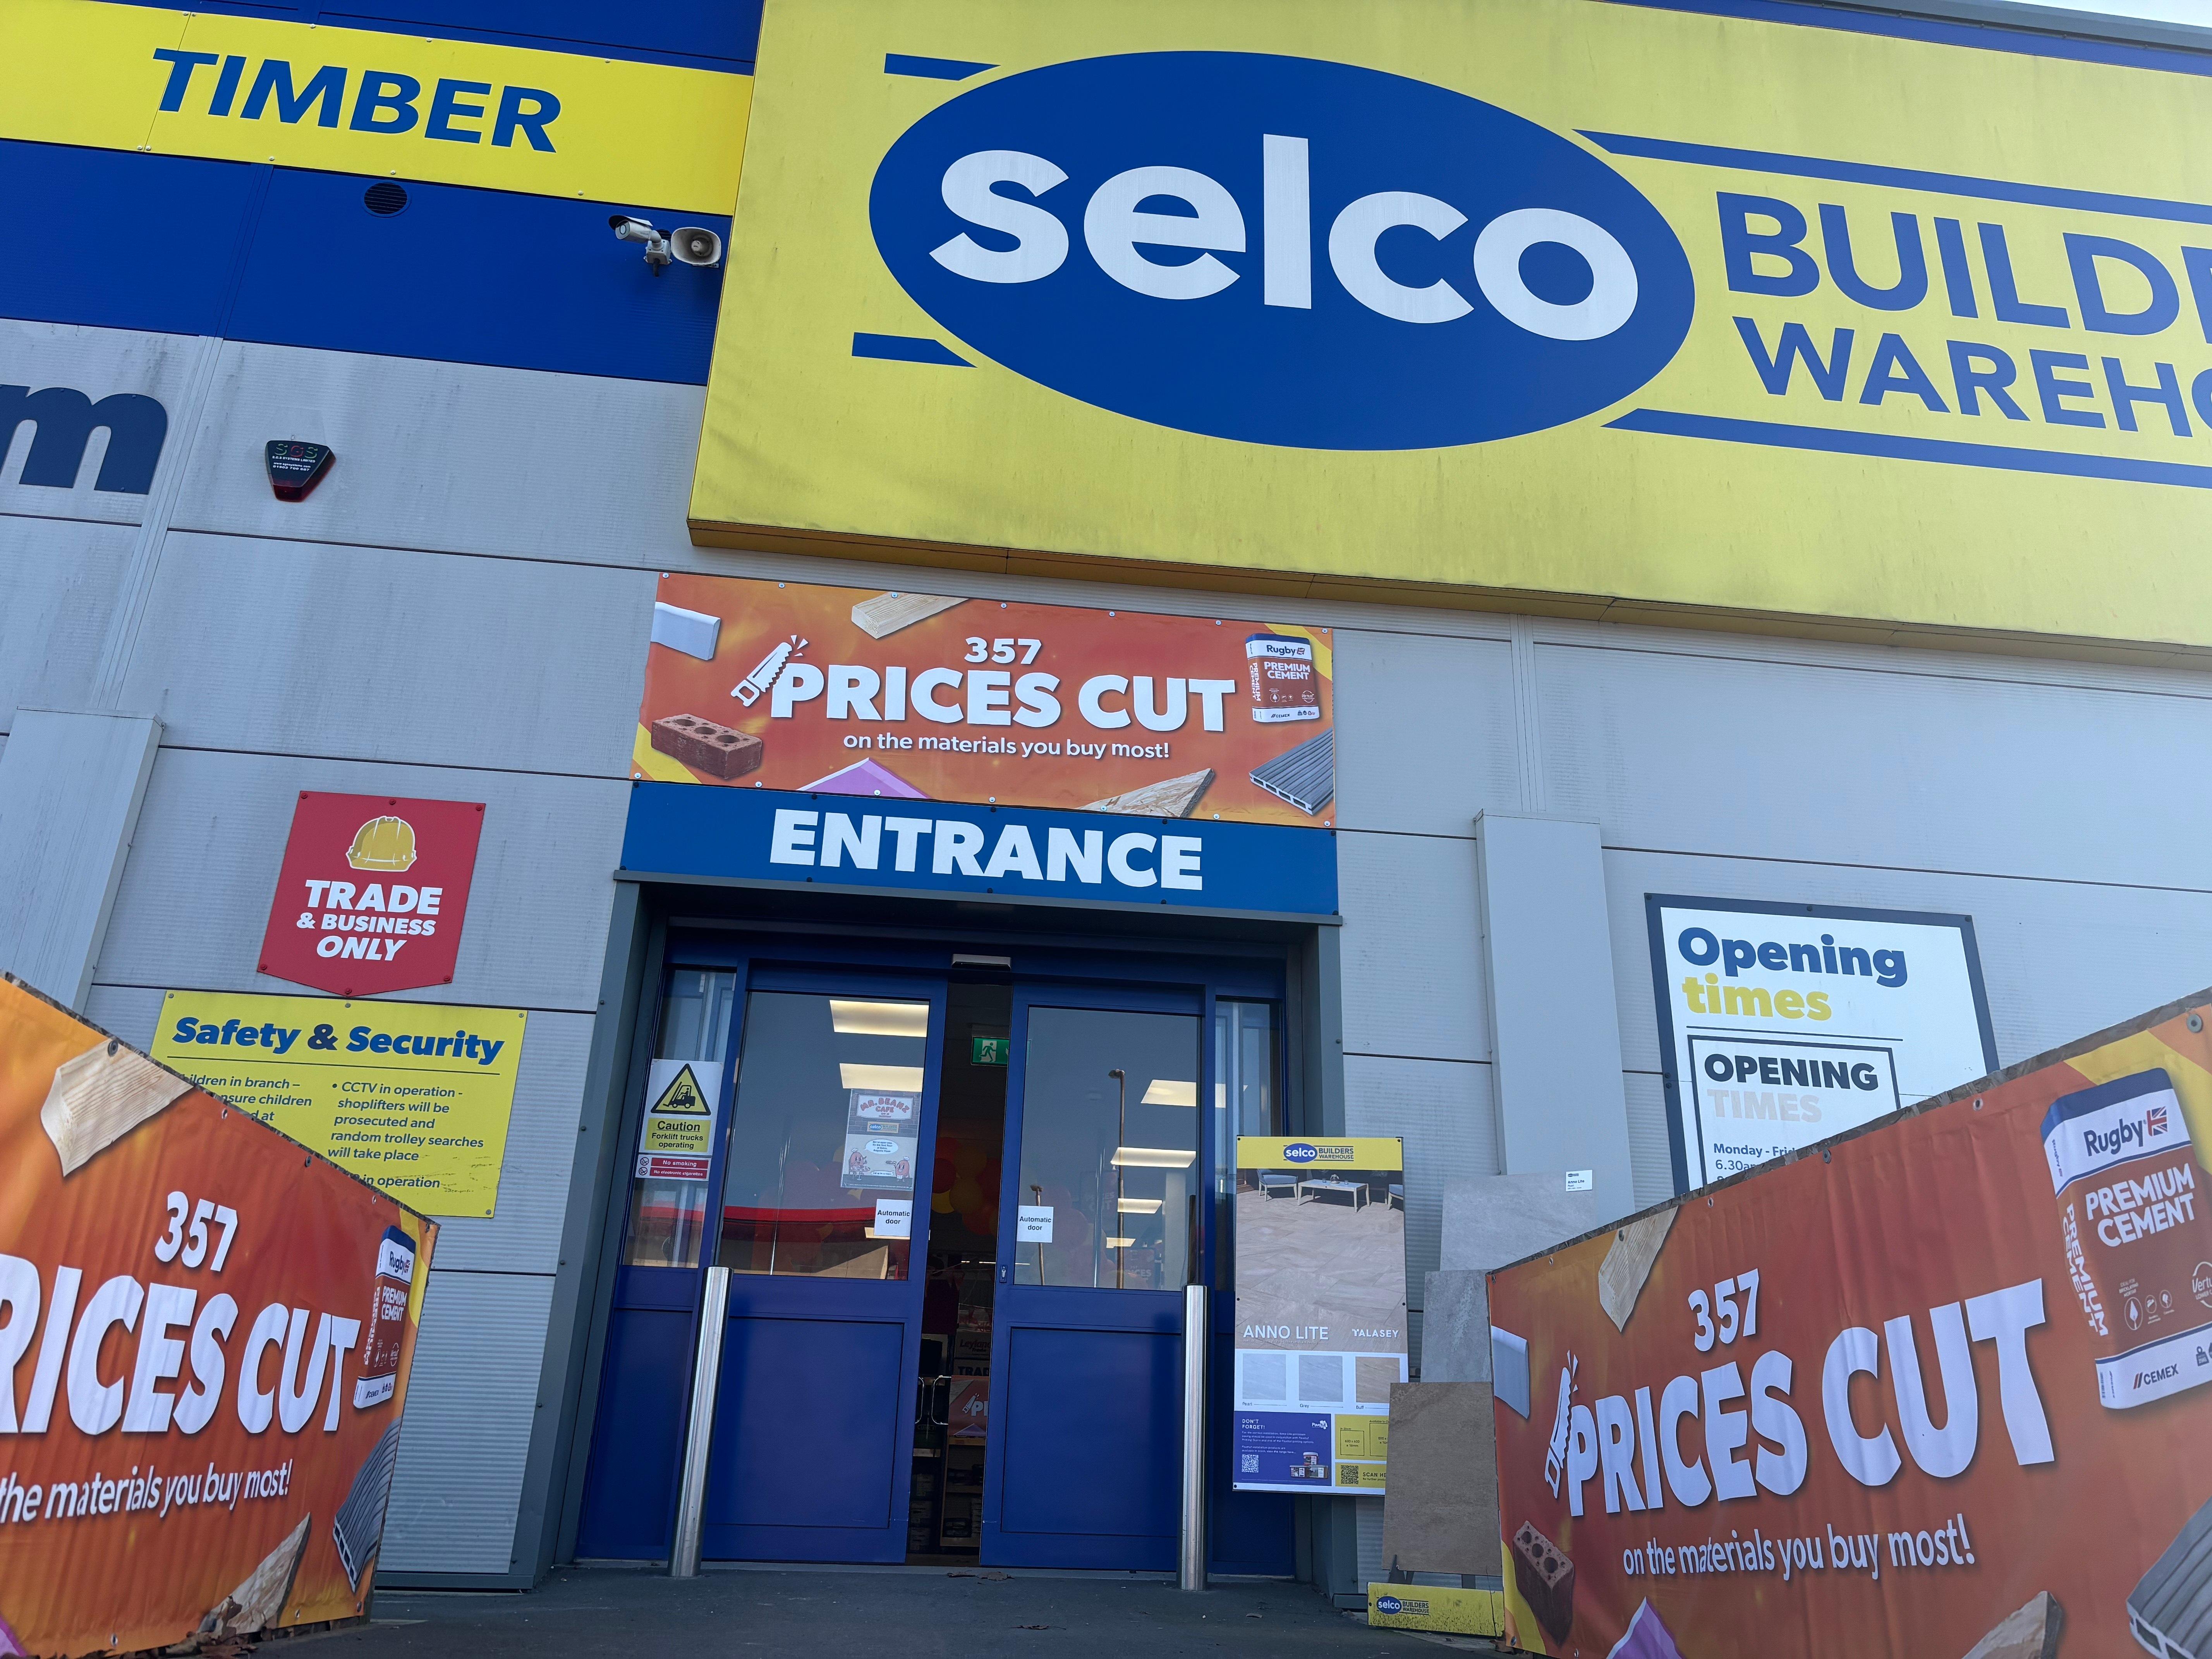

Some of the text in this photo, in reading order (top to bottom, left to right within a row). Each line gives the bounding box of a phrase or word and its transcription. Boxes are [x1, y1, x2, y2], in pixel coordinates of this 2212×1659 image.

[153, 48, 562, 153] TIMBER
[929, 134, 1638, 340] selco
[1732, 316, 2212, 437] WAREH
[965, 637, 1042, 665] 357
[1266, 645, 1295, 656] Rugby
[1264, 661, 1310, 673] PREMIUM
[1267, 671, 1309, 680] CEMENT
[1253, 663, 1261, 701] PREMIUM
[770, 664, 1235, 732] PRICES CUT
[843, 732, 1170, 761] on the materials you buy most!
[769, 809, 1203, 891] ENTRANCE
[306, 880, 443, 915] TRADE
[297, 912, 436, 936] & BUSINESS
[316, 936, 407, 961] ONLY
[1678, 927, 1908, 988] Opening
[1681, 972, 1832, 1021] times
[172, 1017, 504, 1065] Safety & Security
[230, 1076, 241, 1086] in
[245, 1077, 290, 1089] branch
[1704, 1053, 1879, 1091] OPENING
[259, 1094, 312, 1106] children
[342, 1082, 378, 1092] CCTV
[380, 1084, 390, 1094] in
[394, 1086, 455, 1097] operation
[261, 1111, 275, 1121] at
[338, 1098, 450, 1113] shoplifters will be
[878, 1098, 910, 1113] BEANZ
[1707, 1089, 1822, 1123] TIMES
[334, 1116, 435, 1128] prosecuted and
[657, 1120, 700, 1131] Caution
[331, 1131, 484, 1147] random trolley searches
[2083, 1118, 2144, 1156] Rugby
[328, 1147, 419, 1161] will take place
[1286, 1147, 1316, 1157] selco
[1714, 1144, 1762, 1158] Monday
[377, 1176, 440, 1188] operation
[2085, 1163, 2195, 1221] PREMIUM
[155, 1191, 237, 1272] 357
[2097, 1192, 2195, 1247] CEMENT
[390, 1250, 405, 1274] Rugby
[2062, 1216, 2099, 1334] CEMENT
[2066, 1203, 2108, 1336] PREMIUM
[382, 1286, 407, 1307] PREMIUM
[381, 1304, 404, 1322] CEMENT
[1688, 1268, 1759, 1352] 357
[1243, 1325, 1329, 1340] ANNO LITE
[1352, 1329, 1398, 1338] TALASEY
[237, 1303, 361, 1434] CUT
[2143, 1364, 2179, 1385] CEMEX
[1567, 1278, 2055, 1517] PRICES CUT
[45, 1465, 163, 1519] materials
[160, 1467, 199, 1518] you
[203, 1462, 244, 1511] buy
[244, 1459, 293, 1499] most!
[1623, 1513, 1975, 1582] on the materials you buy most!
[1378, 1600, 1400, 1609] selco
